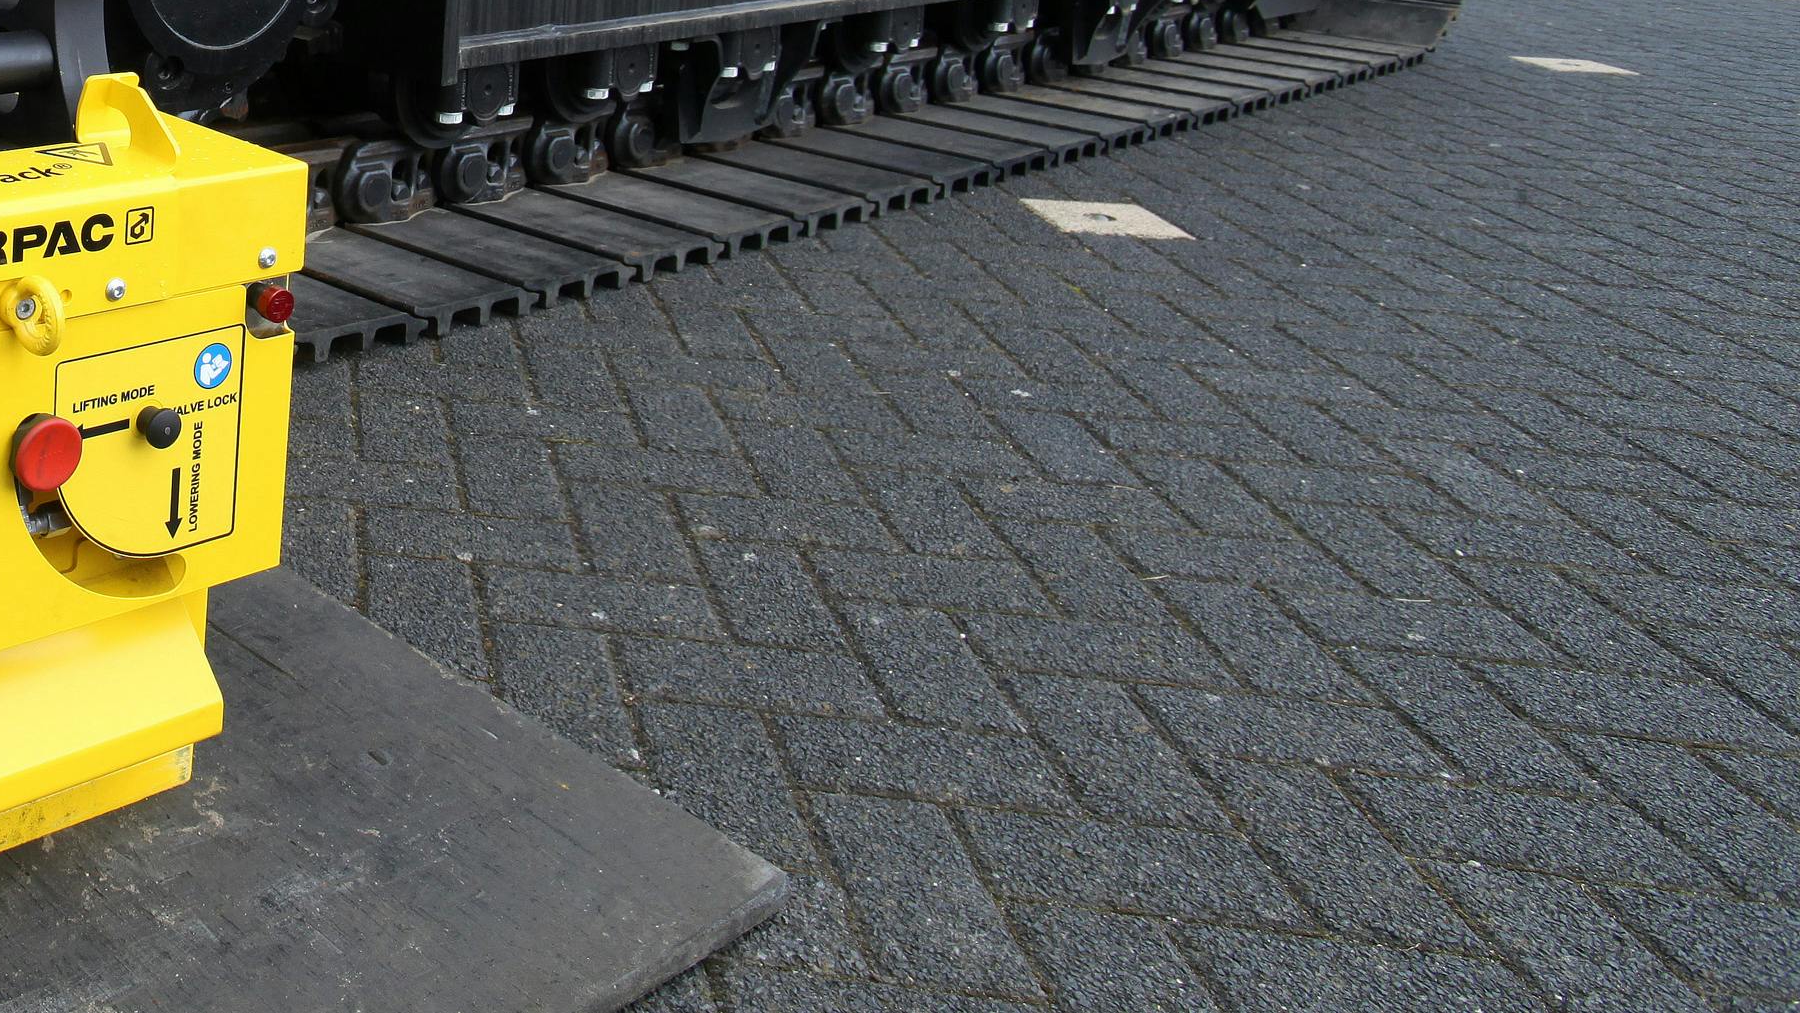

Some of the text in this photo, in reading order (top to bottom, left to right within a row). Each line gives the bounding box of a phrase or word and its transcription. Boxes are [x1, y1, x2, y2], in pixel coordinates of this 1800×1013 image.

[72, 384, 156, 414] LIFTING MODE
[207, 392, 238, 409] LOCK
[188, 421, 203, 532] LOWERING MODE
